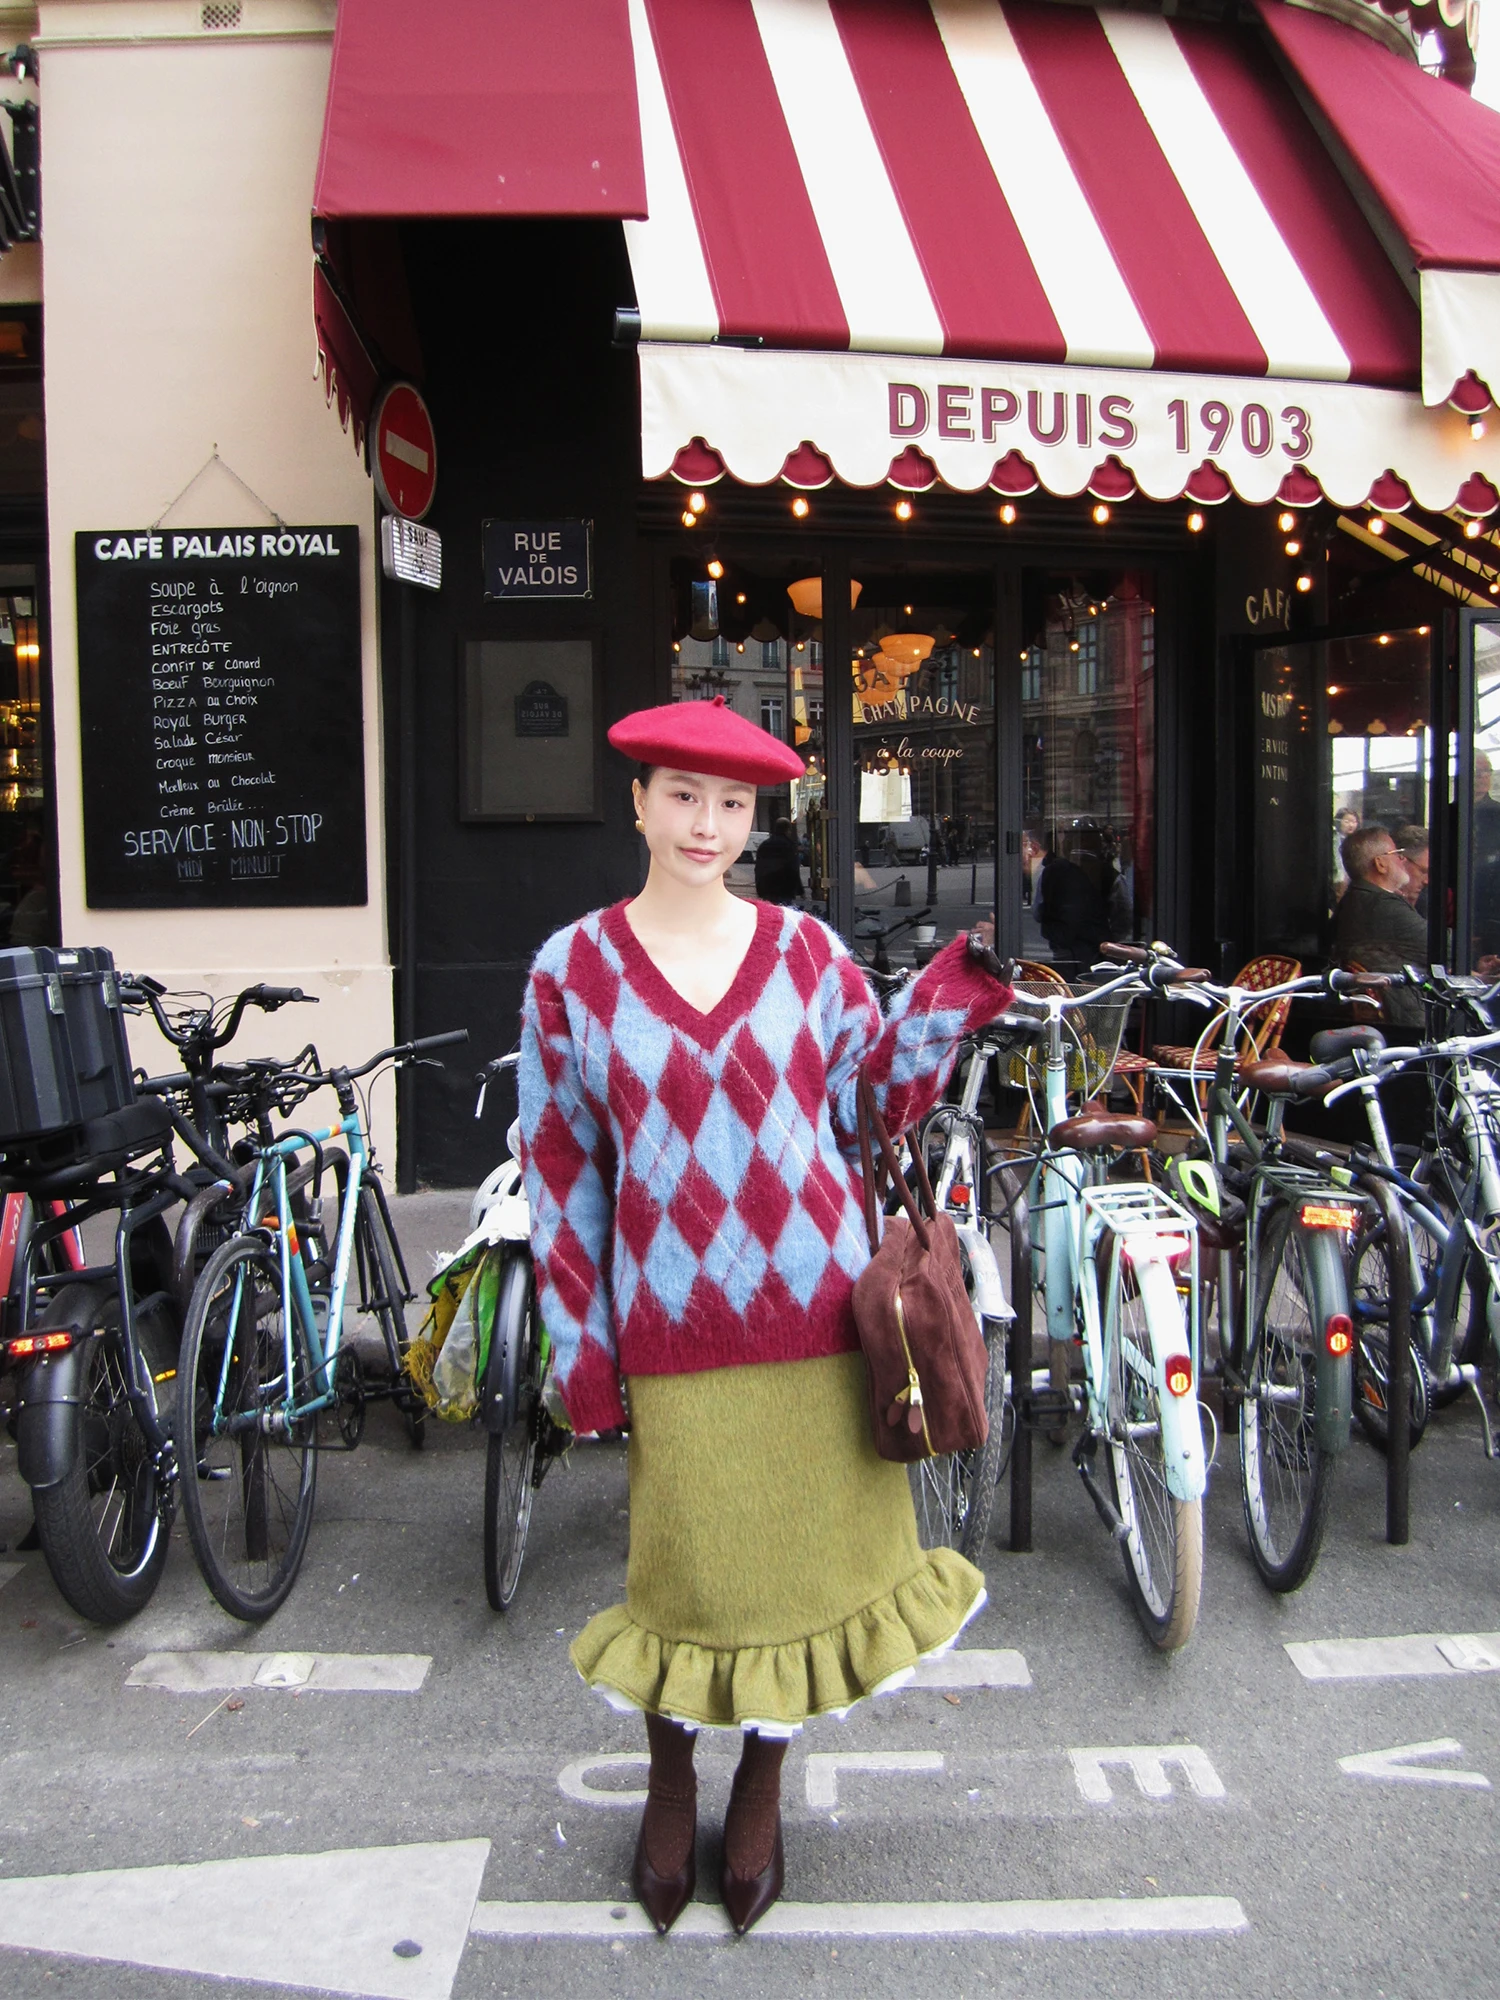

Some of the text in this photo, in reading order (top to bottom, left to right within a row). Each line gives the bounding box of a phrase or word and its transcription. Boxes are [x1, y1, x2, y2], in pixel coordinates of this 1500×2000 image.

[887, 382, 1312, 461] DEPUIS 1903
[94, 533, 341, 561] CAFE PALAIS ROYAL
[514, 531, 562, 551] RUE
[529, 553, 548, 564] DE
[498, 565, 579, 585] VALOIS
[209, 578, 225, 596] à
[151, 600, 225, 621] Escargots
[151, 620, 222, 641] Foie gras
[152, 639, 233, 657] ENTRECÔTE
[202, 660, 216, 671] DE
[207, 696, 221, 707] au
[860, 694, 981, 726] CHAMPAGNE
[153, 714, 192, 732] Royal
[154, 731, 243, 751] Salade César
[896, 736, 915, 759] la
[920, 746, 964, 767] coupe
[156, 757, 197, 771] Croque
[231, 771, 277, 787] Chocolat
[160, 803, 196, 818] Crème
